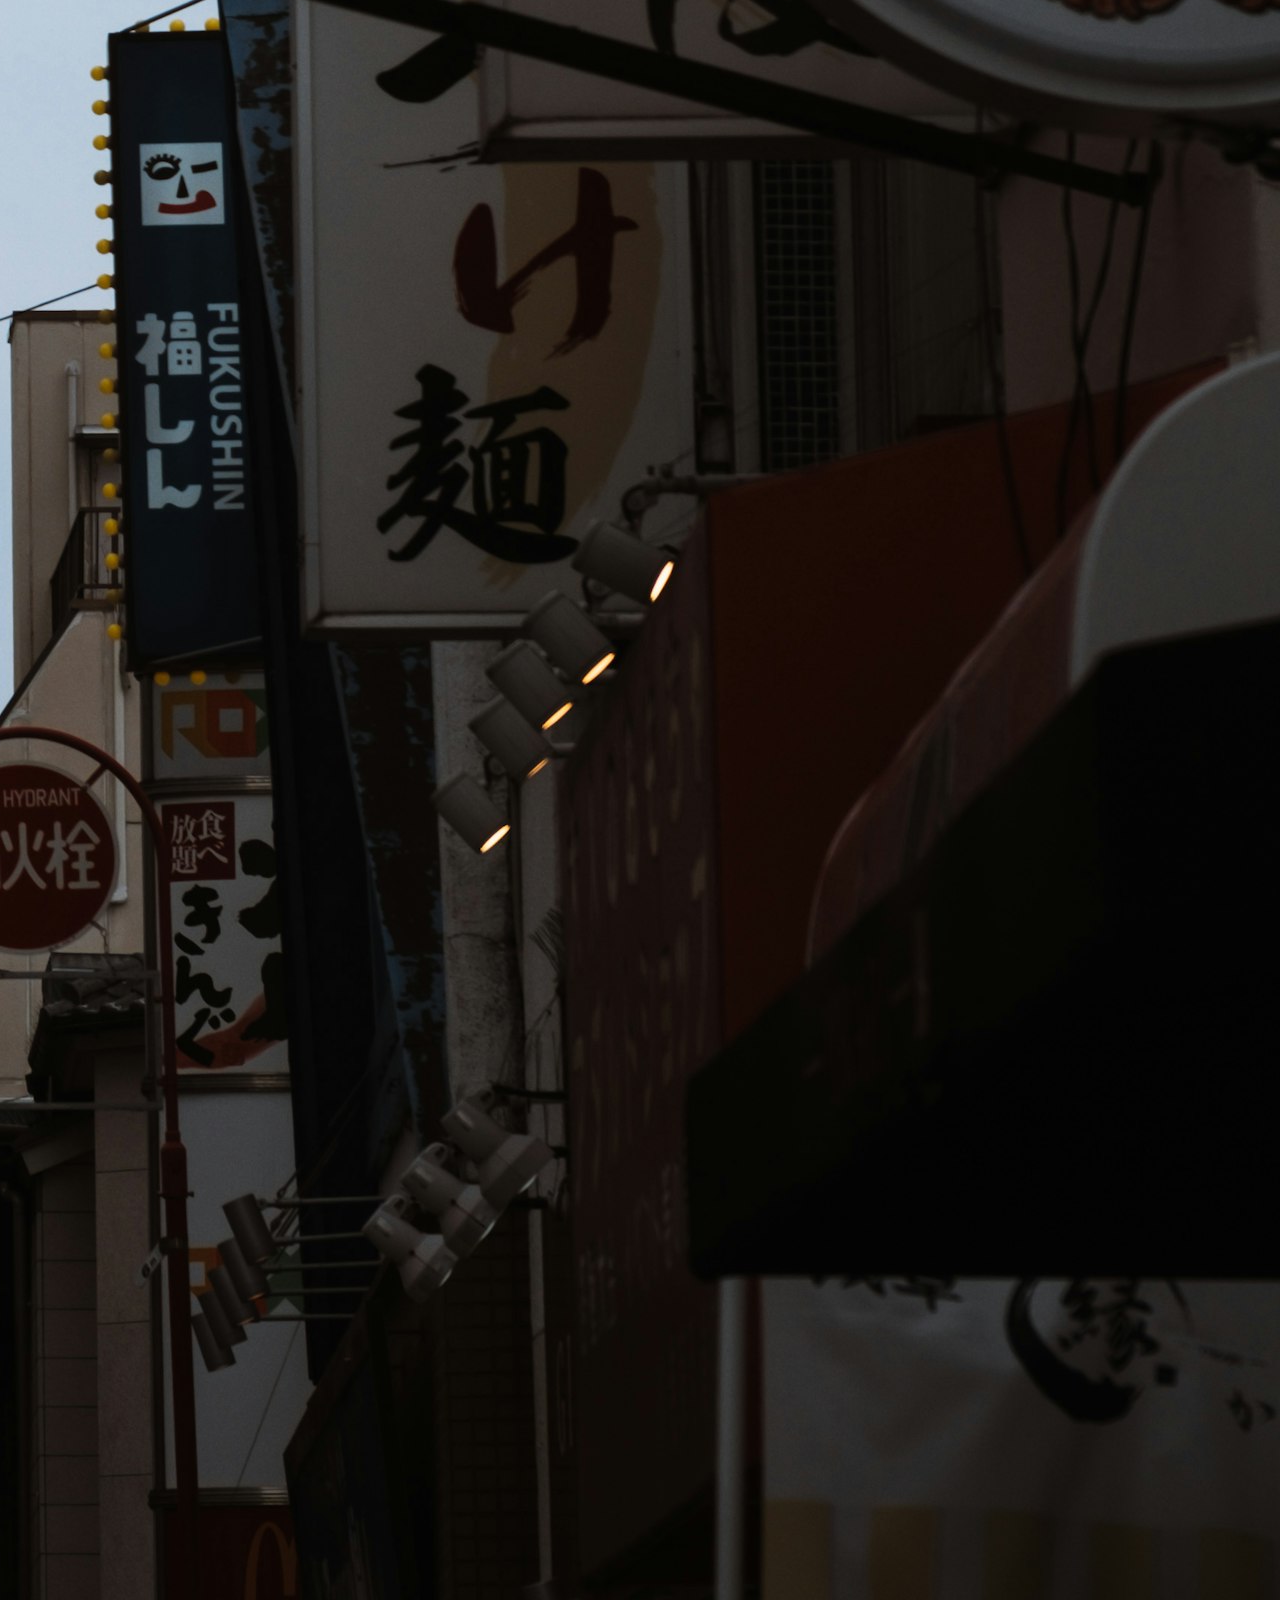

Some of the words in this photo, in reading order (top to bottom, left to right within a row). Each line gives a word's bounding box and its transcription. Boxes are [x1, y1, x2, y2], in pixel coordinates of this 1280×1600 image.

[134, 310, 203, 510] 福しん
[206, 302, 246, 511] FUKUSHIN
[2, 786, 82, 809] HYDRANT
[174, 883, 237, 1067] きんぐ
